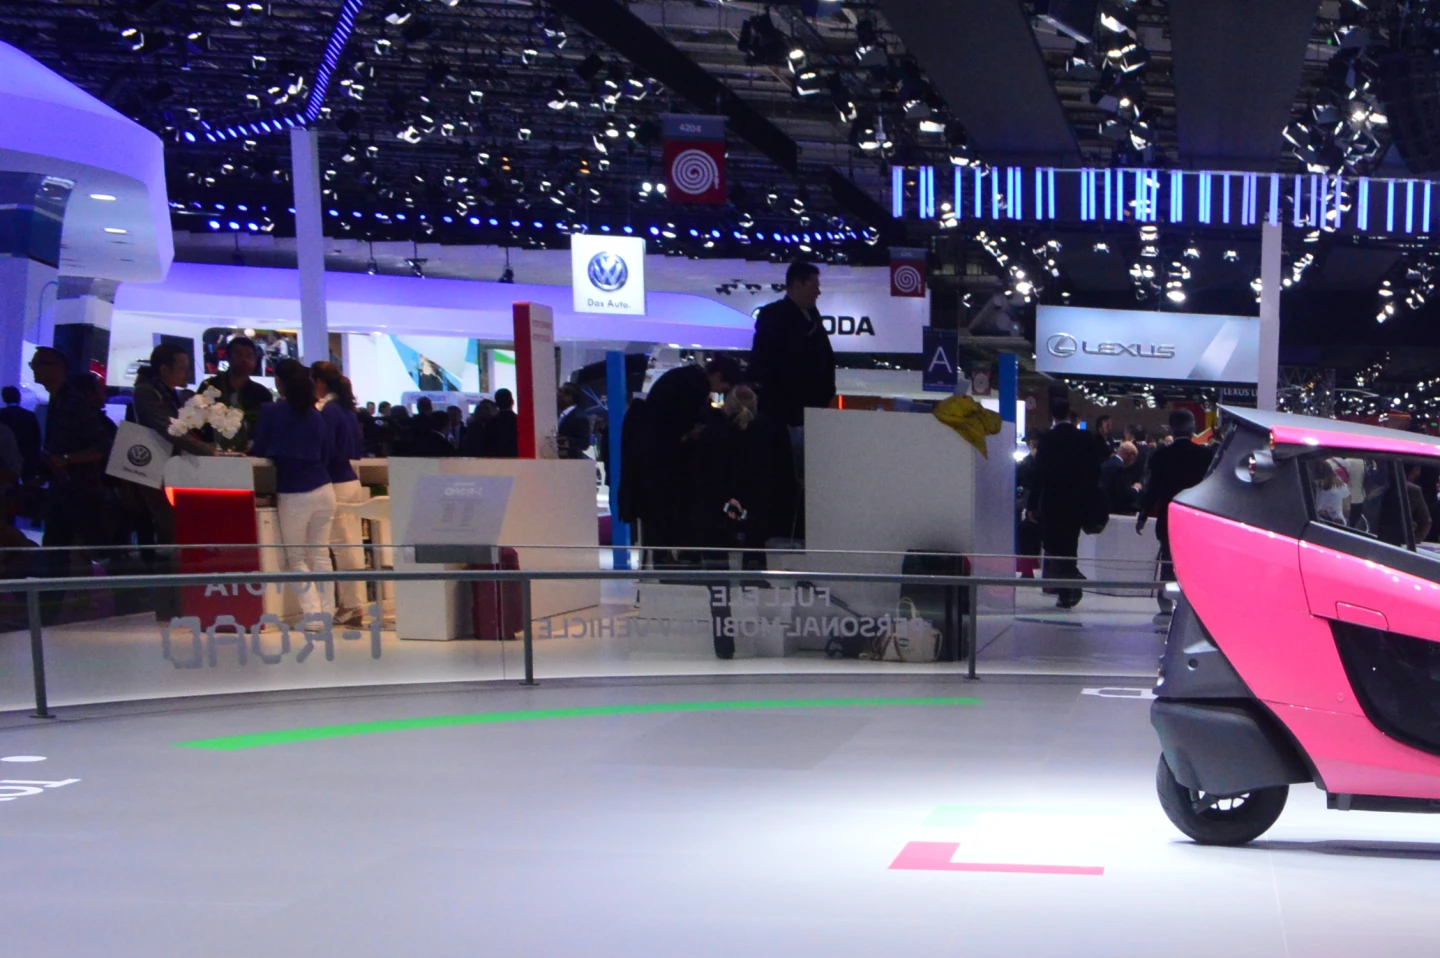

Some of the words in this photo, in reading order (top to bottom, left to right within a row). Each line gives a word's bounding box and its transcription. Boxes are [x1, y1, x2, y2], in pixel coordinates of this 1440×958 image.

[587, 297, 604, 307] Das
[821, 315, 876, 336] ODA
[1082, 341, 1175, 359] LEXUS
[928, 346, 953, 374] A
[1223, 387, 1250, 397] LEXUS
